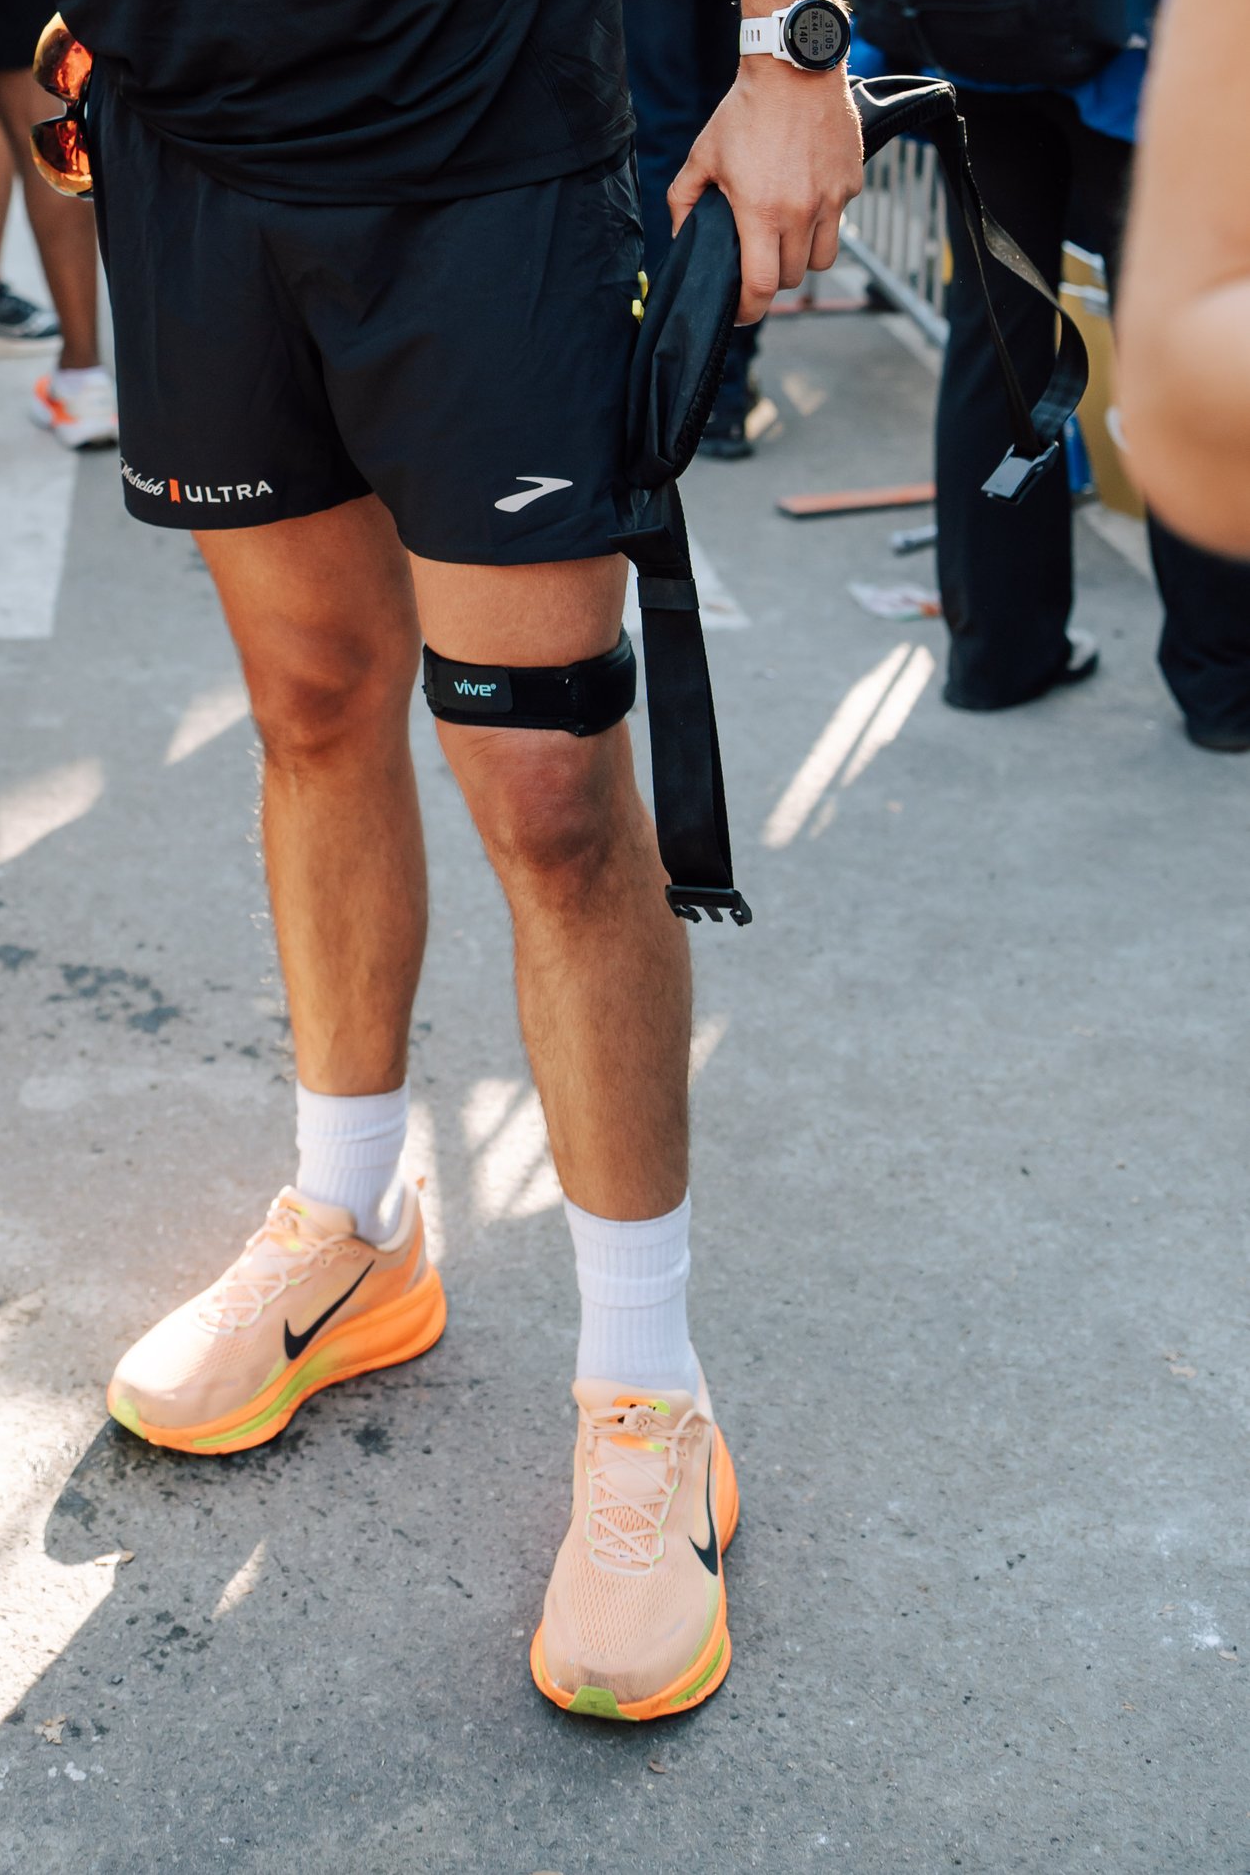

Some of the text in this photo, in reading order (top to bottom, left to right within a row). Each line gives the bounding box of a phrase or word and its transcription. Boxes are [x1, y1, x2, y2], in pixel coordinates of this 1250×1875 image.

[799, 25, 808, 44] 140
[120, 457, 273, 503] Michelob ULTRA
